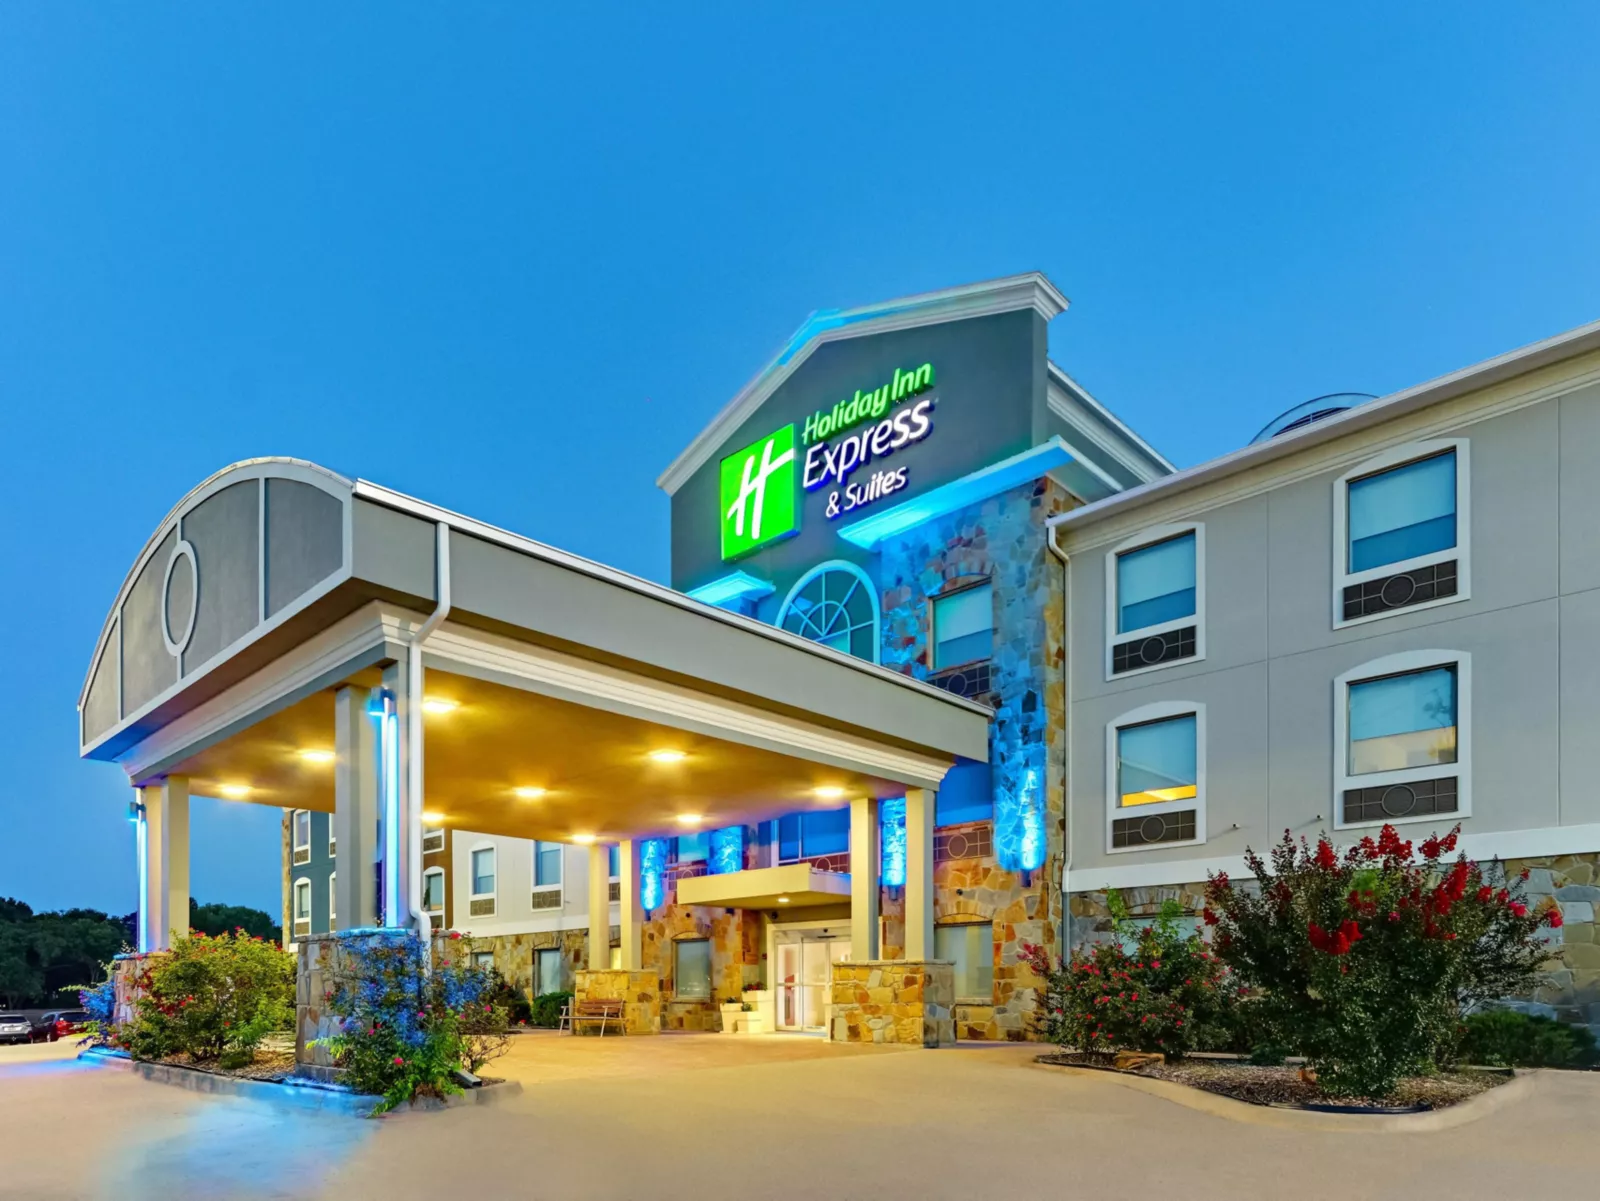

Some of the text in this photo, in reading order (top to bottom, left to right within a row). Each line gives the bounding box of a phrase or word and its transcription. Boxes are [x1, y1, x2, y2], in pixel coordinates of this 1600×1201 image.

[802, 363, 933, 446] Holiday Inn
[803, 400, 931, 488] Express
[825, 467, 908, 518] & Suites
